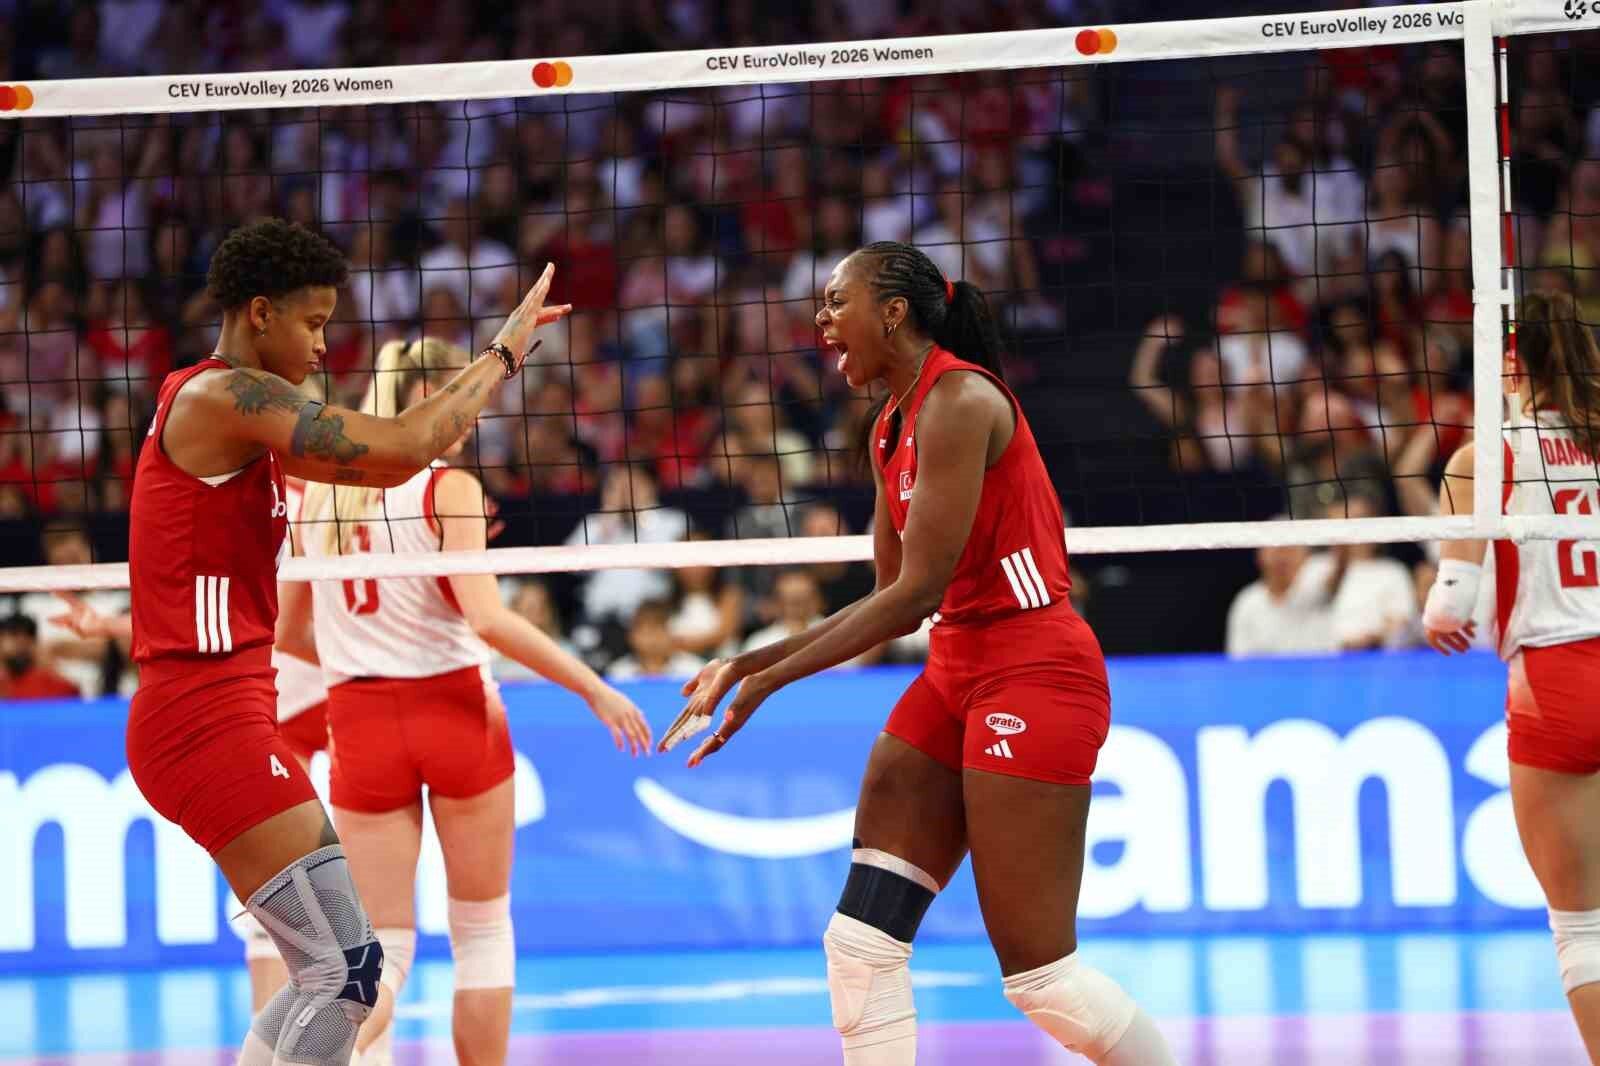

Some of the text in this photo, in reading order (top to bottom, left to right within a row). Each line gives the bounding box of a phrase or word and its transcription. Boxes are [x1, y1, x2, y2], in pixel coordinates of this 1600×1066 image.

[1262, 11, 1464, 37] CEV EuroVolley 2026 Wo
[706, 47, 934, 70] CEV EuroVolley 2026 Women
[168, 77, 393, 98] CEV EuroVolley 2026 Women
[1541, 437, 1600, 466] DAM
[1554, 488, 1600, 588] 2
[989, 715, 1022, 729] gratis
[269, 753, 291, 779] 4
